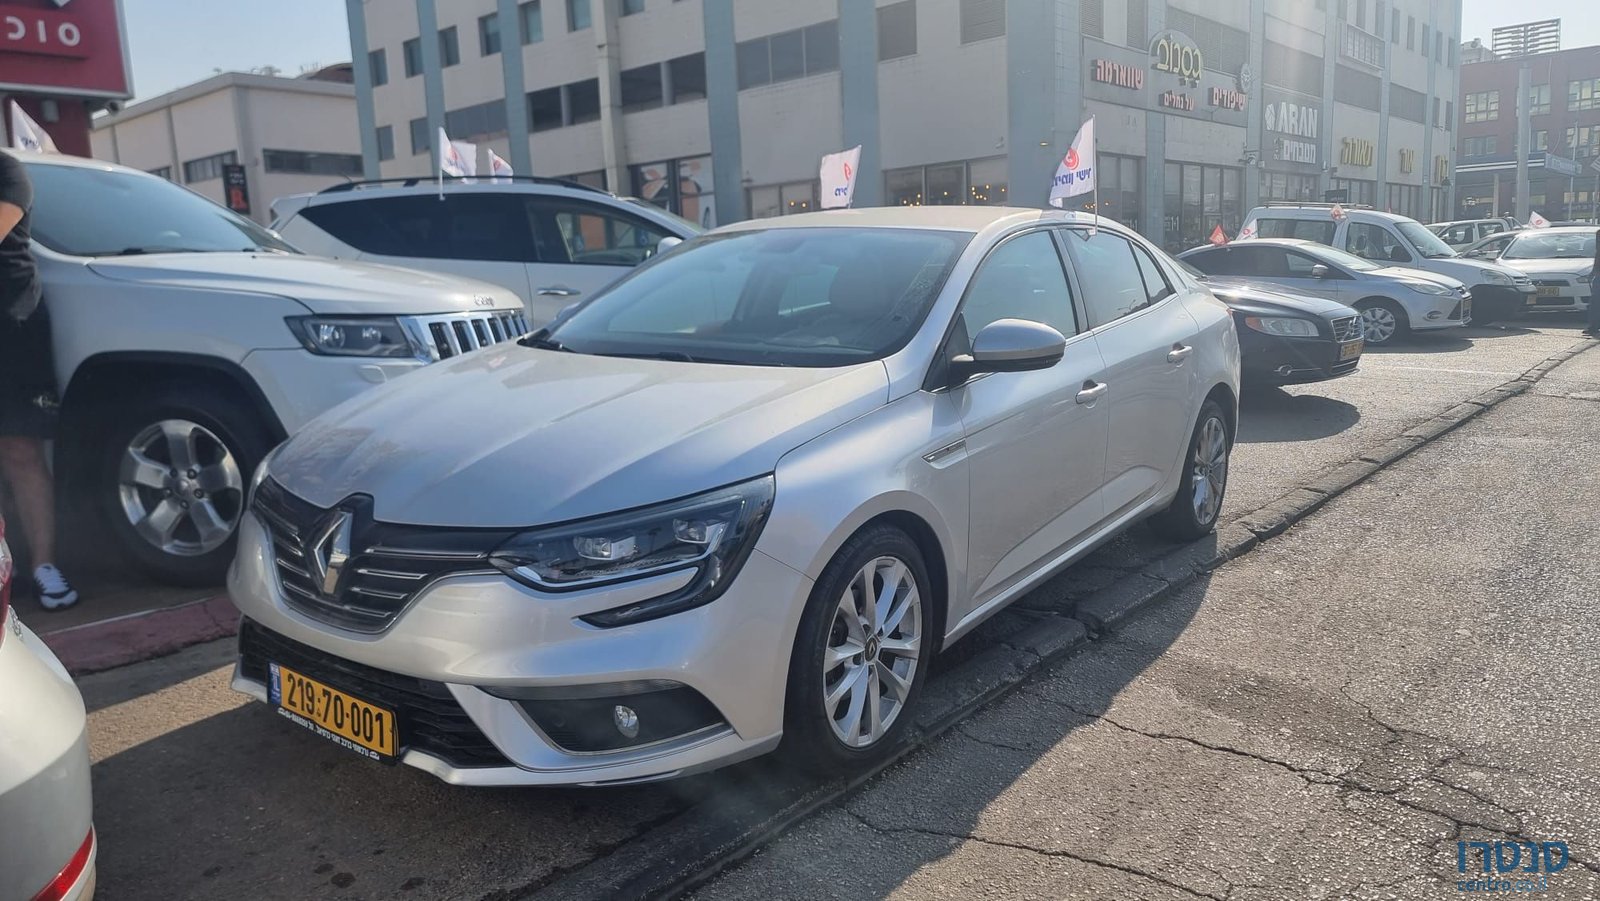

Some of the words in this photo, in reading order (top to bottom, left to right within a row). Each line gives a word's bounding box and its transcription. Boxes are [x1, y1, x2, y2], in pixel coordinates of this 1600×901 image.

[1096, 59, 1144, 90] שווארמה
[1213, 87, 1247, 112] שיפודים
[1276, 102, 1318, 138] ARAN
